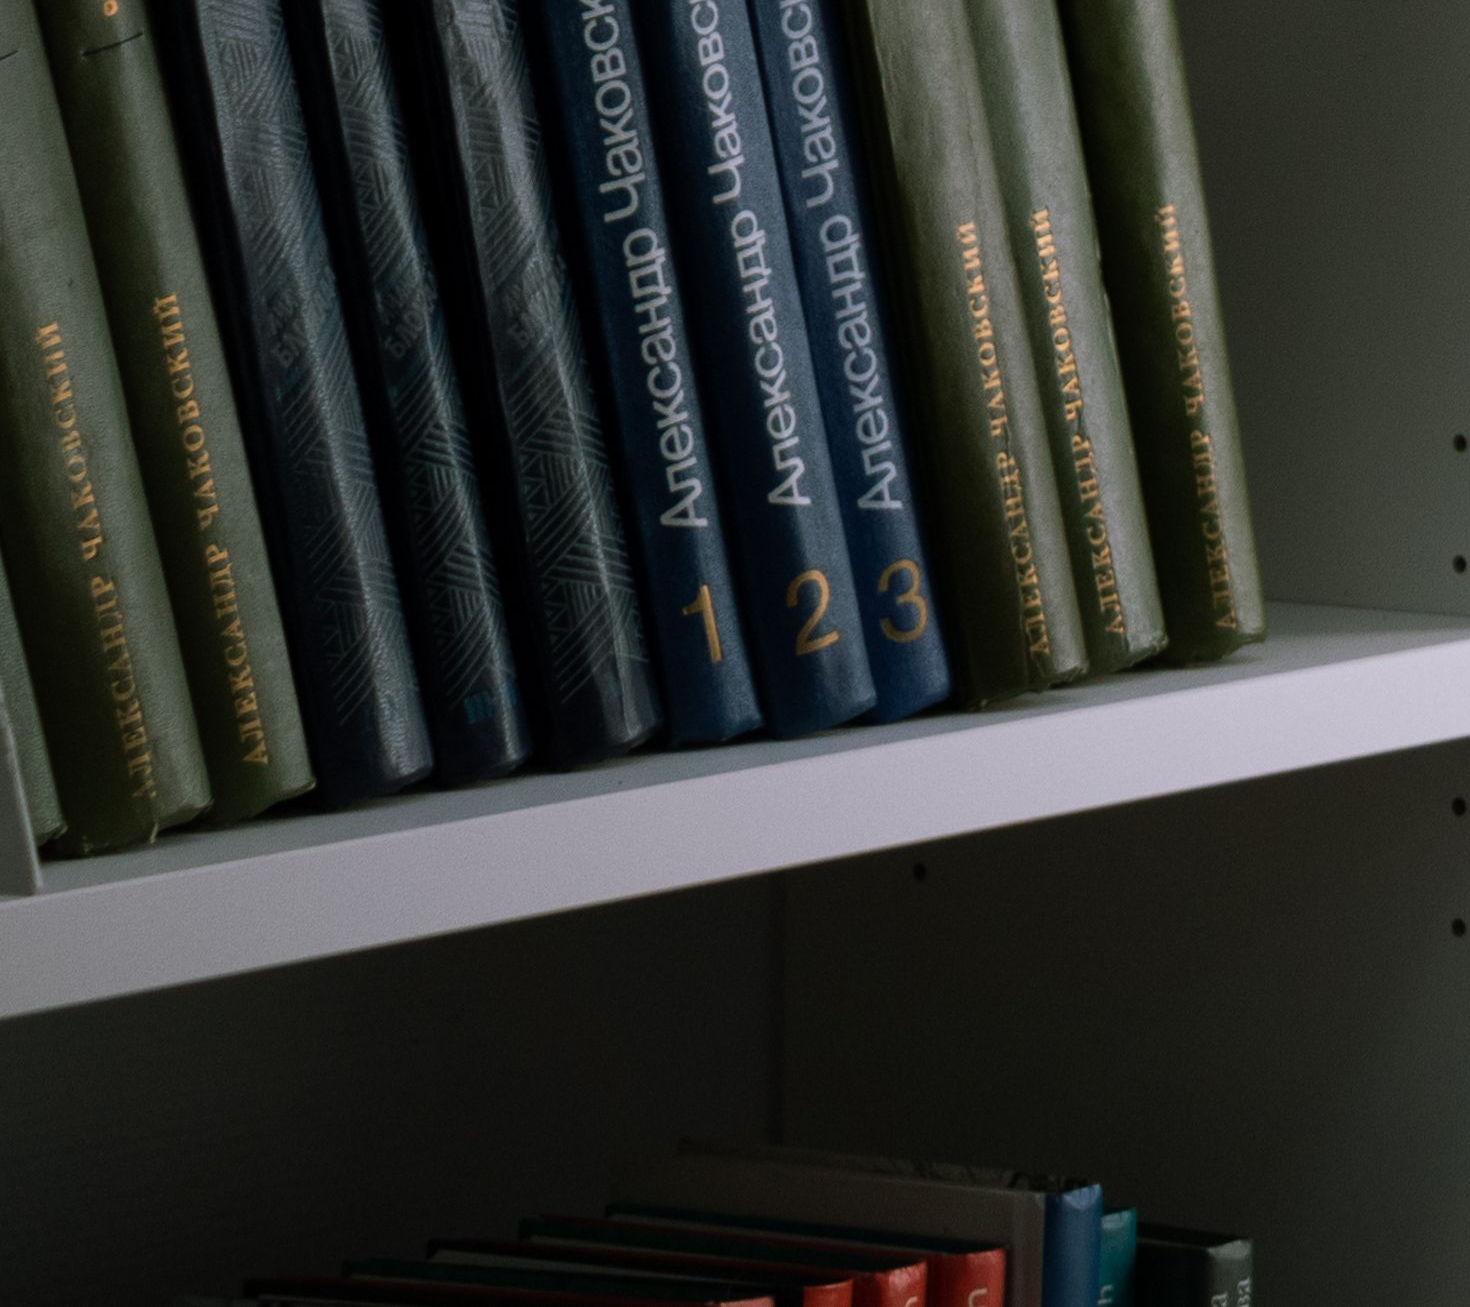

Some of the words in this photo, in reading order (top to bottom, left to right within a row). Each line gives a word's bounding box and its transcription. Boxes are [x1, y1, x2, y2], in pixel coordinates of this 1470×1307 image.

[151, 291, 220, 529] ЧАКОВСКИЙ
[622, 227, 709, 528] Александр
[731, 209, 812, 506] Александр
[818, 213, 903, 512] Александр
[955, 220, 1009, 437] ЧАКОВСКИЙ
[1031, 205, 1085, 423] ЧАКОВСКИЙ
[1155, 203, 1208, 418] ЧАКОВСКИЙ
[35, 320, 107, 562] ЧАКОВСКИЙ
[1072, 432, 1125, 639] АЛЕКСАНДР
[1192, 427, 1241, 632] АЛЕКСАНДР
[206, 541, 270, 766] АЛЕКСАНДР
[681, 584, 724, 665] 1
[786, 569, 841, 657] 2
[877, 559, 929, 644] 3
[995, 450, 1052, 659] АЛЕКСАНДР
